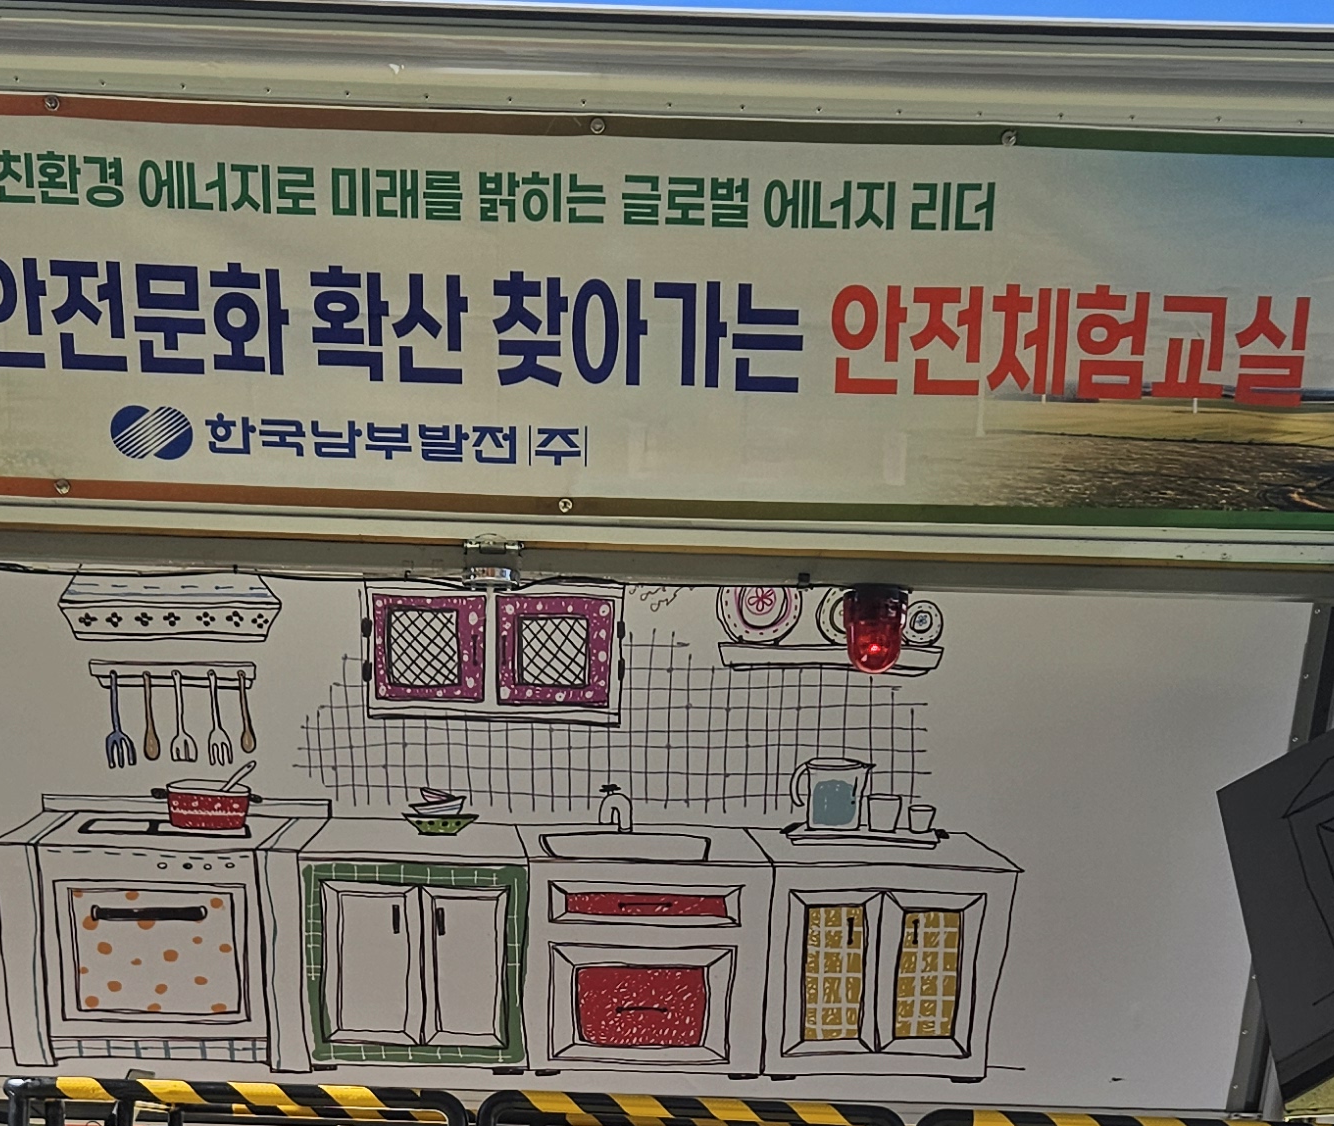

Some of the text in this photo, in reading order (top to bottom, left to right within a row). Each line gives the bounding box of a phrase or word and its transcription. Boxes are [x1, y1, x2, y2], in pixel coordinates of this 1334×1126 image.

[139, 159, 316, 217] 에너지로
[331, 167, 463, 221] 미래를
[477, 171, 606, 224] 밝히는
[621, 174, 750, 228] 글로벌
[764, 179, 896, 230] 에너지
[910, 181, 996, 231] 리더
[310, 265, 468, 384] 확산
[492, 270, 804, 393] 찾아가는
[831, 283, 1312, 407] 안전체험교실
